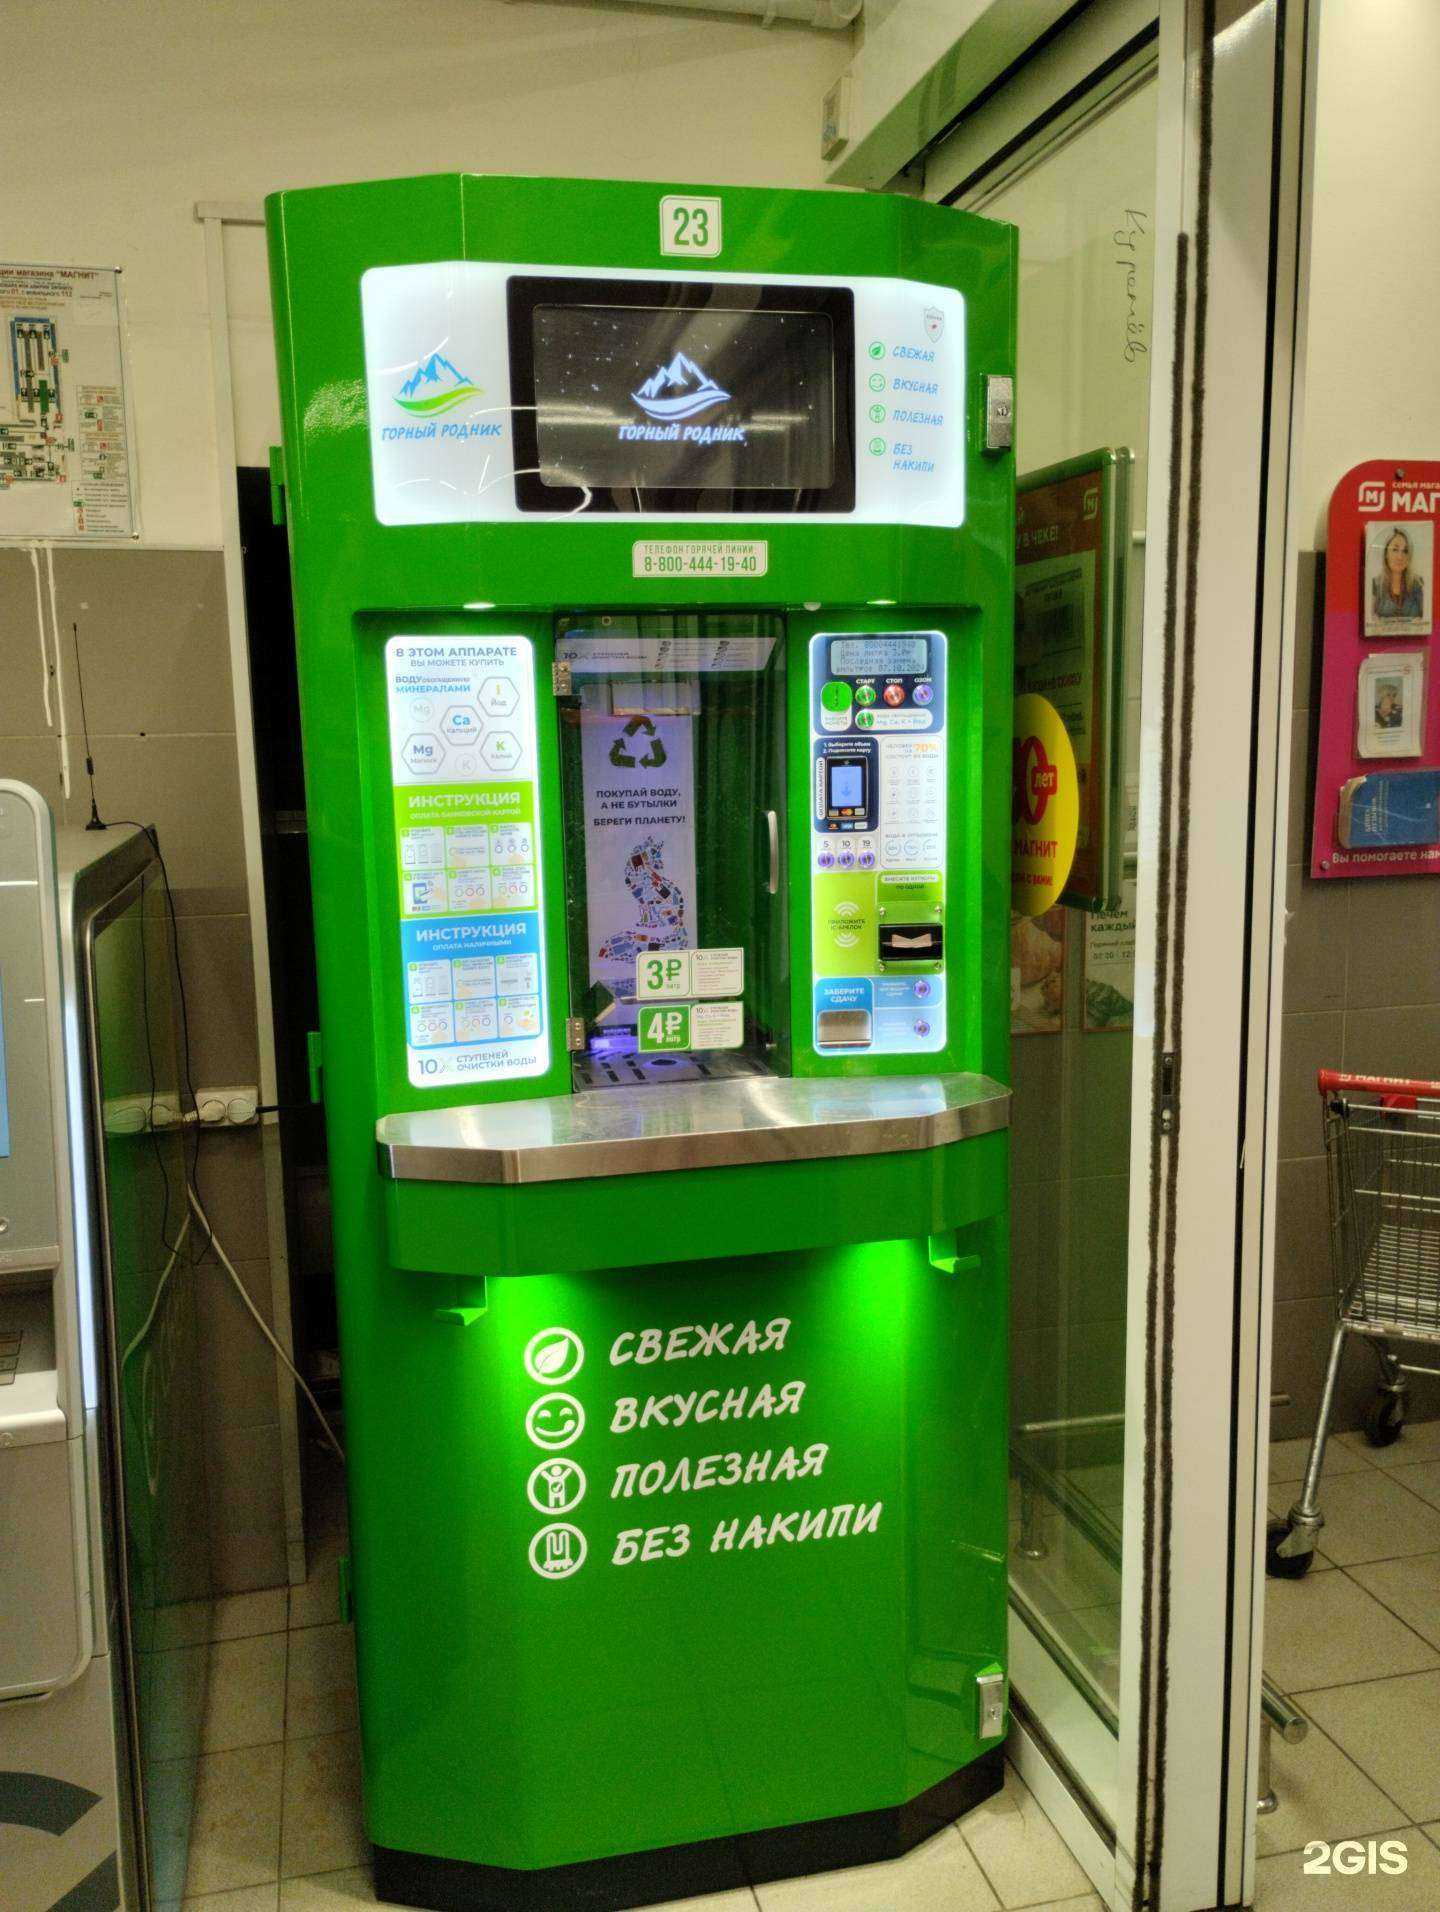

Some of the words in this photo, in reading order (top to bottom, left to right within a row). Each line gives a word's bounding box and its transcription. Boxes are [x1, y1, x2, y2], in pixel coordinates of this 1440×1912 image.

[672, 207, 709, 247] 23
[892, 346, 935, 362] СВЕЖАЯ
[892, 378, 939, 395] ВКУСНАЯ
[892, 410, 944, 426] ПОЛЕЗНАЯ
[382, 422, 437, 440] ГОРНЫЙ
[441, 424, 502, 439] РОДНИК
[618, 423, 680, 440] ГОРНЫЙ
[683, 425, 746, 444] РОДНИК
[893, 443, 912, 456] БЕЗ
[893, 460, 935, 472] НАКИПИ
[644, 545, 684, 554] ТЕЛЕФОН
[685, 545, 722, 554] ГОРЯЧЕЙ
[725, 544, 754, 554] ЛИНИИ
[644, 556, 757, 572] 8-800-444-19-40
[396, 648, 404, 657] В
[408, 648, 445, 657] ЭТОМ
[448, 647, 517, 657] АППАРАТЕ
[427, 659, 467, 667] МОЖЕТЕ
[469, 658, 505, 666] КУПИТЬ
[395, 676, 422, 684] ВОДУ
[395, 685, 471, 693] МИНЕРАЛАМИ
[452, 715, 471, 726] Ca
[413, 745, 434, 756] Mg
[408, 792, 520, 808] ИНСТРУКЦИЯ
[596, 788, 648, 798] ПОКУПАЙ
[650, 788, 681, 798] ВОДУ,
[611, 801, 625, 809] НЕ
[627, 800, 677, 809] БУТЫЛКИ
[594, 817, 632, 826] БЕРЕГИ
[635, 815, 686, 825] ПЛАНЕТУ!
[1332, 852, 1349, 863] Вы
[1352, 850, 1417, 862] помогаете
[416, 922, 527, 941] ИНСТРУКЦИЯ
[433, 943, 462, 951] ОПЛАТА
[830, 995, 858, 1003] СДАЧУ
[418, 1059, 438, 1075] 10
[456, 1051, 509, 1063] СТУПЕНЕЙ
[456, 1061, 505, 1071] ОЧИСТКИ
[506, 1056, 537, 1066] ВОДЫ
[608, 1317, 792, 1366] СВЕЖАЯ
[609, 1381, 806, 1433] ВКУСНАЯ
[610, 1443, 829, 1499] ПОЛЕЗНАЯ
[611, 1523, 691, 1566] БЕЗ
[710, 1501, 883, 1553] НАКИПИ
